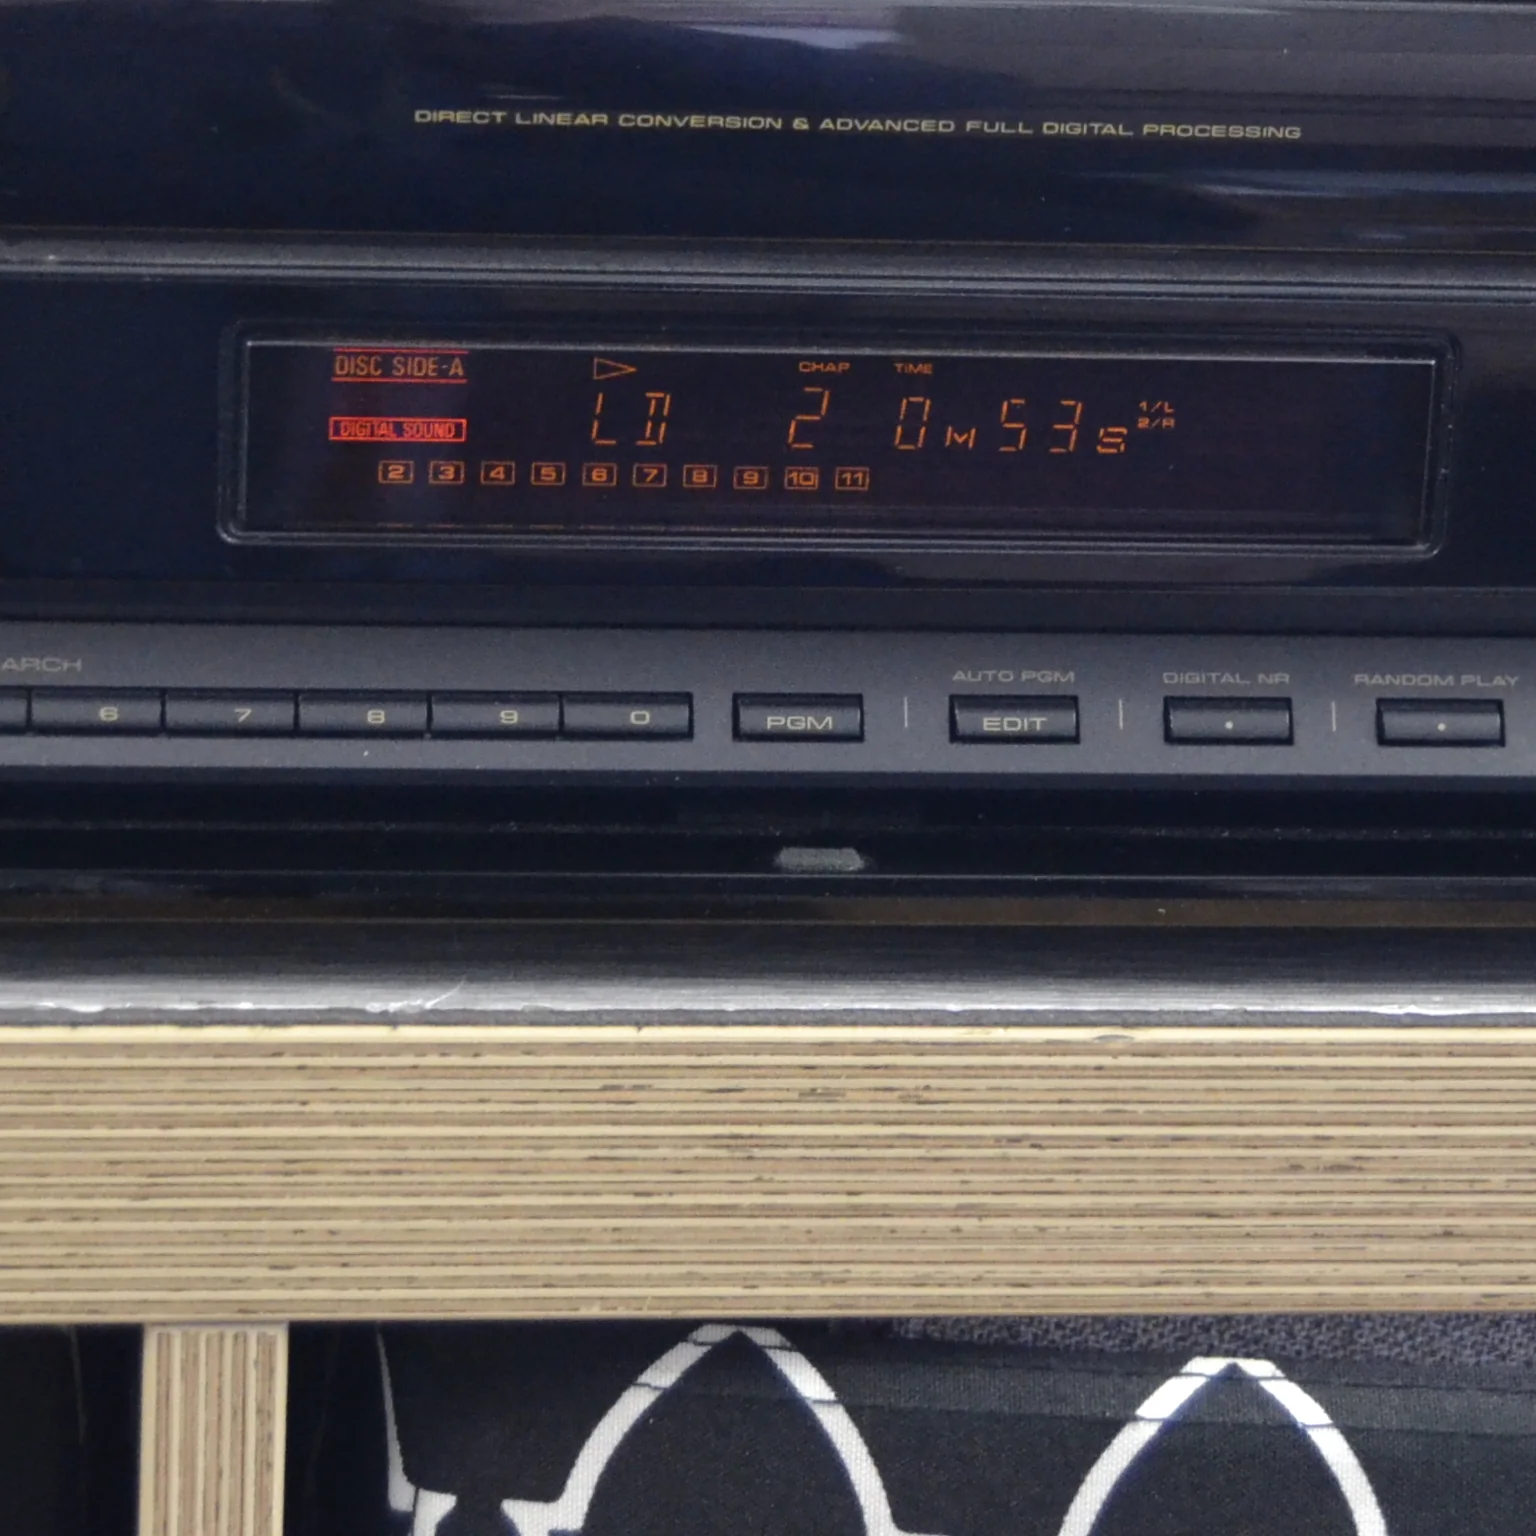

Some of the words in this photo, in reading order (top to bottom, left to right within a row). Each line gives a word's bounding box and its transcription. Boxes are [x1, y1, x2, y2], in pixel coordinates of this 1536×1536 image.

[414, 109, 507, 125] DIRECT
[515, 111, 609, 127] LINEAR
[618, 113, 782, 131] CONVERSION
[792, 117, 810, 131] &
[819, 117, 956, 133] ADVANCED
[965, 120, 1034, 135] FULL
[1042, 121, 1134, 137] DIGITAL
[1142, 123, 1302, 140] PROCESSING
[334, 355, 383, 377] DISC
[391, 355, 464, 378] SIDE-A
[798, 360, 851, 374] CHAP
[893, 362, 934, 375] TIME
[786, 386, 831, 450] 2
[340, 419, 398, 439] DIGITAL
[402, 419, 456, 440] SOUND
[386, 465, 406, 481] 2
[437, 465, 456, 481] 3
[488, 466, 507, 481] 4
[538, 467, 557, 482] 5
[590, 467, 608, 482] 6
[640, 468, 659, 483] 7
[690, 468, 710, 484] 8
[742, 470, 761, 485] 9
[787, 470, 817, 486] 10
[840, 471, 865, 486] 11
[951, 669, 1013, 683] AUTO
[1021, 670, 1076, 683] PGM
[1162, 672, 1252, 686] DIGITAL
[1258, 673, 1290, 686] NR
[1353, 673, 1455, 687] RANDOM
[1461, 674, 1520, 688] PLAY
[98, 706, 119, 722] 6
[233, 708, 253, 723] 7
[366, 709, 386, 724] 8
[499, 710, 519, 725] 9
[766, 715, 834, 731] PGM
[982, 716, 1048, 733] EDIT
